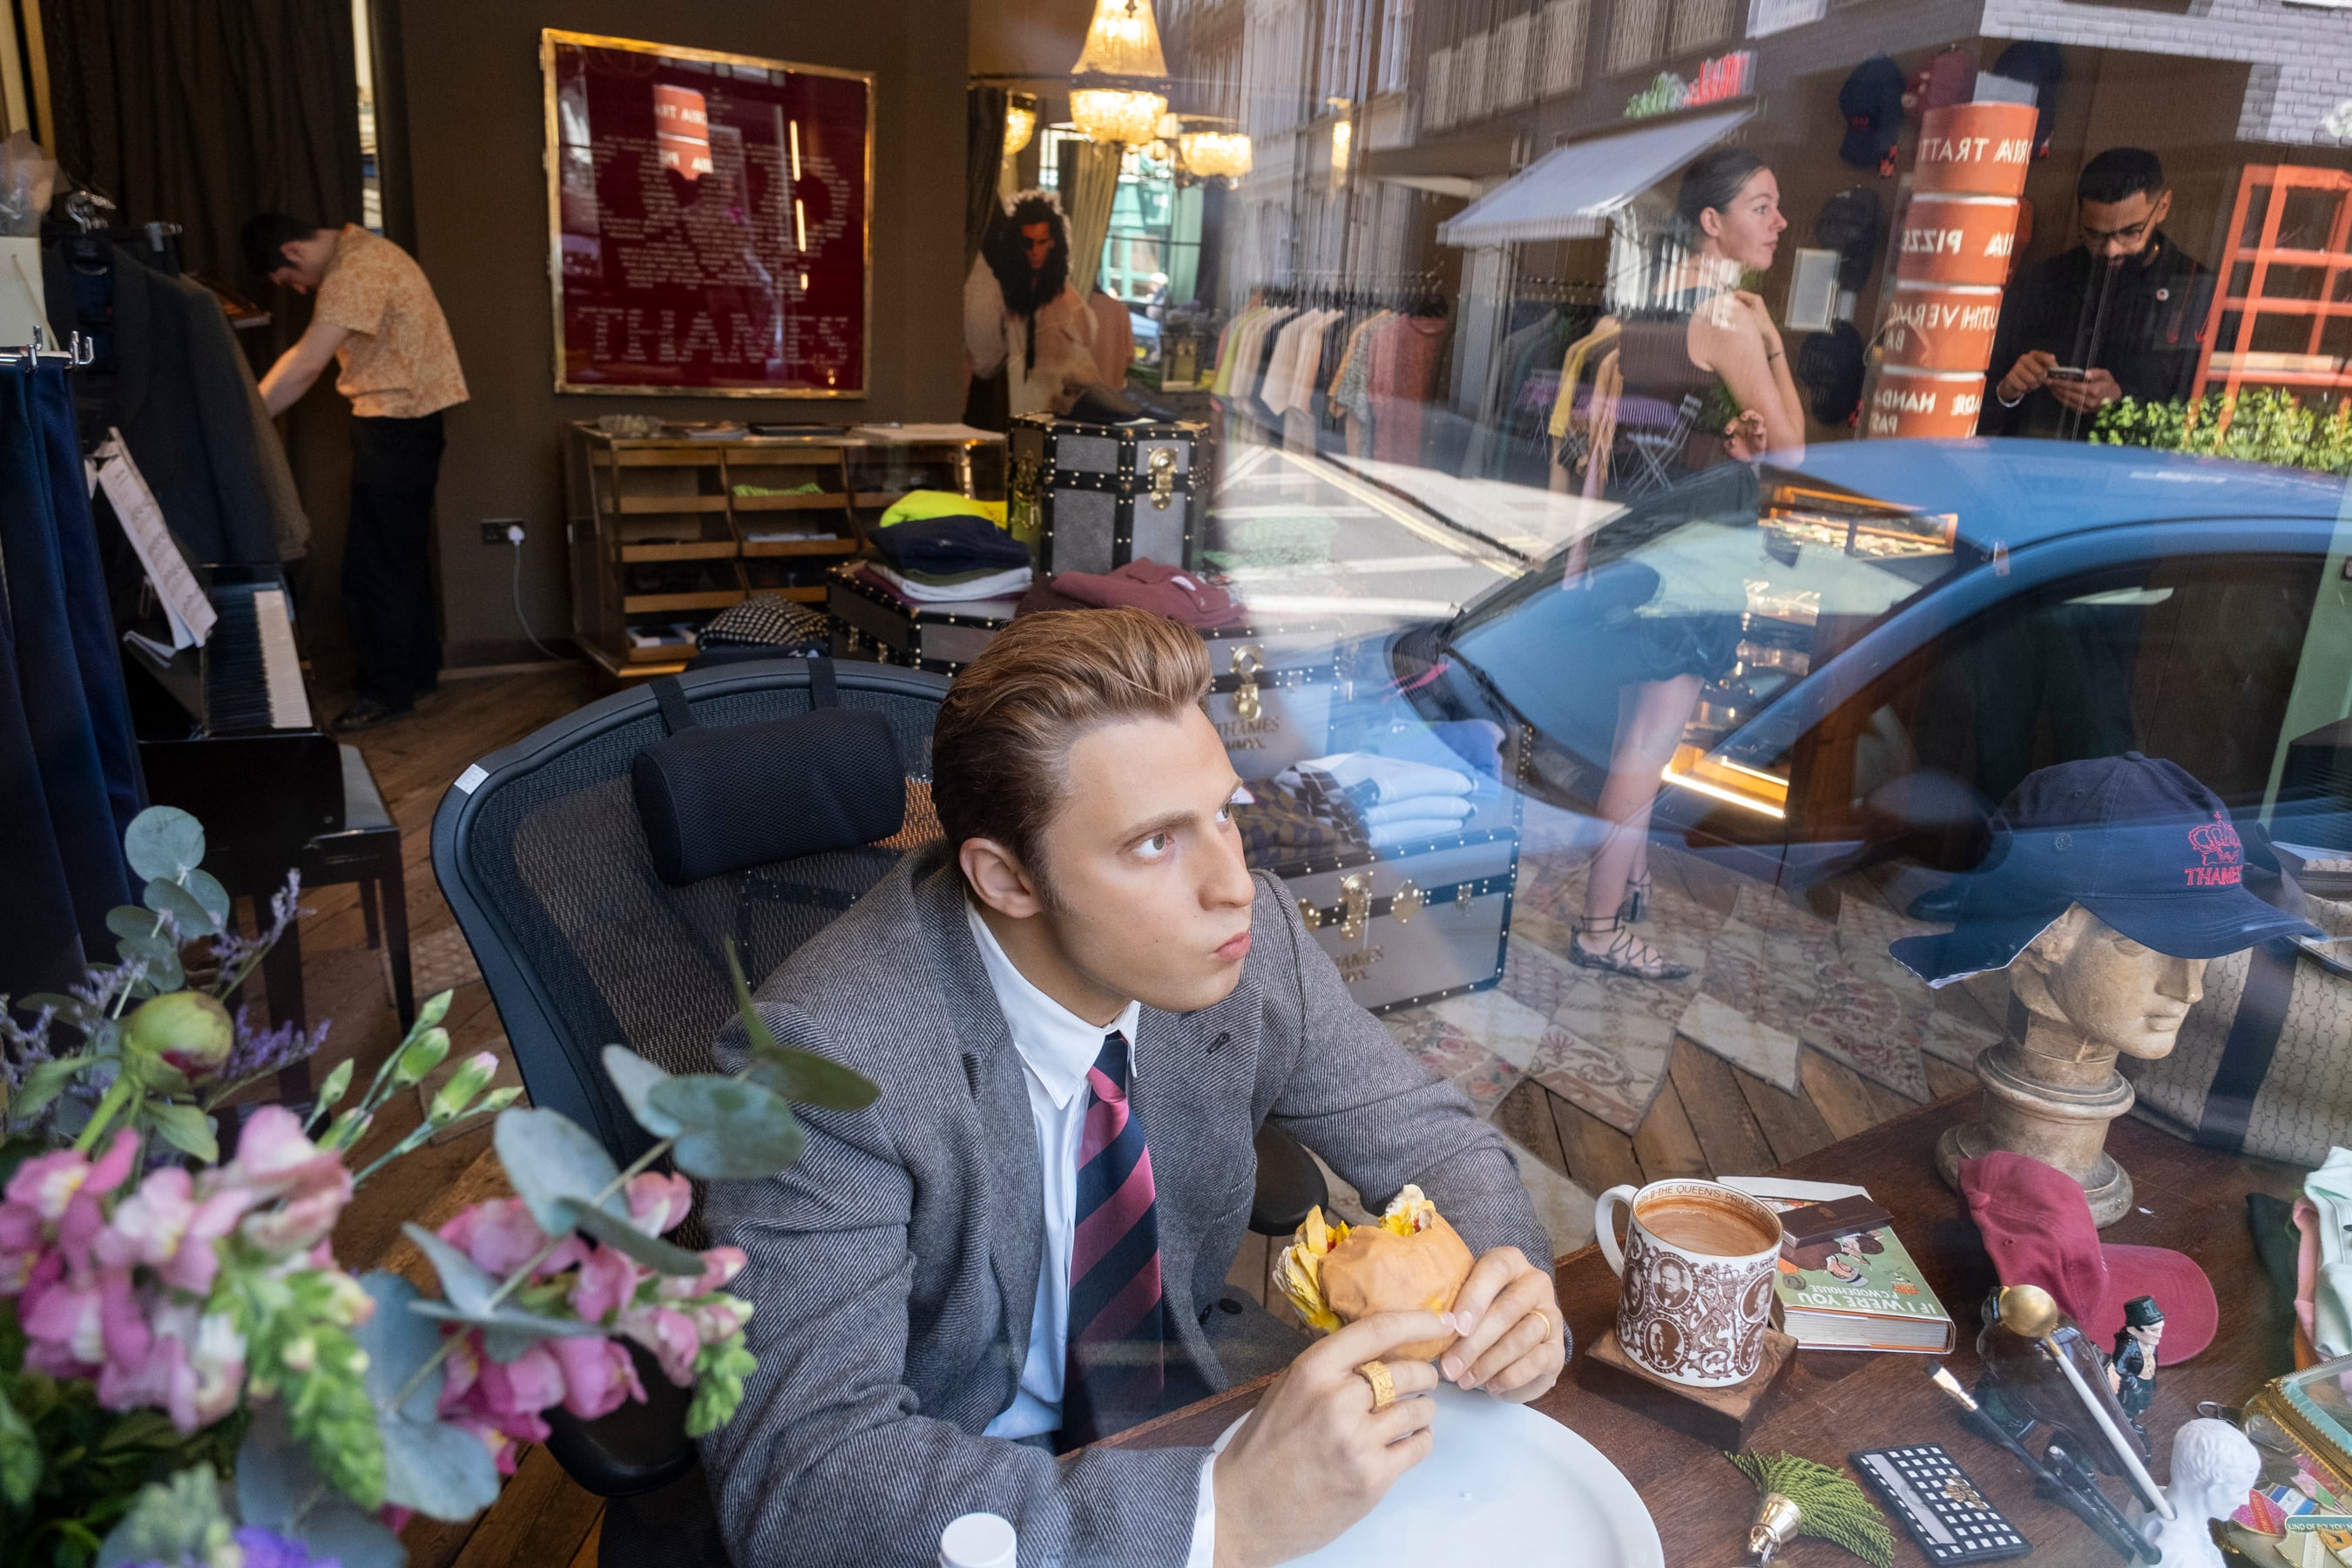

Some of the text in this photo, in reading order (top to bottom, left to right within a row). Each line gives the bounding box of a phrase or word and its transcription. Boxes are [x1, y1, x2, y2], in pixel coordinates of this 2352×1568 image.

[1725, 1193, 1754, 1211] PRIME
[1797, 1291, 1938, 1315] IF I WERE YOU
